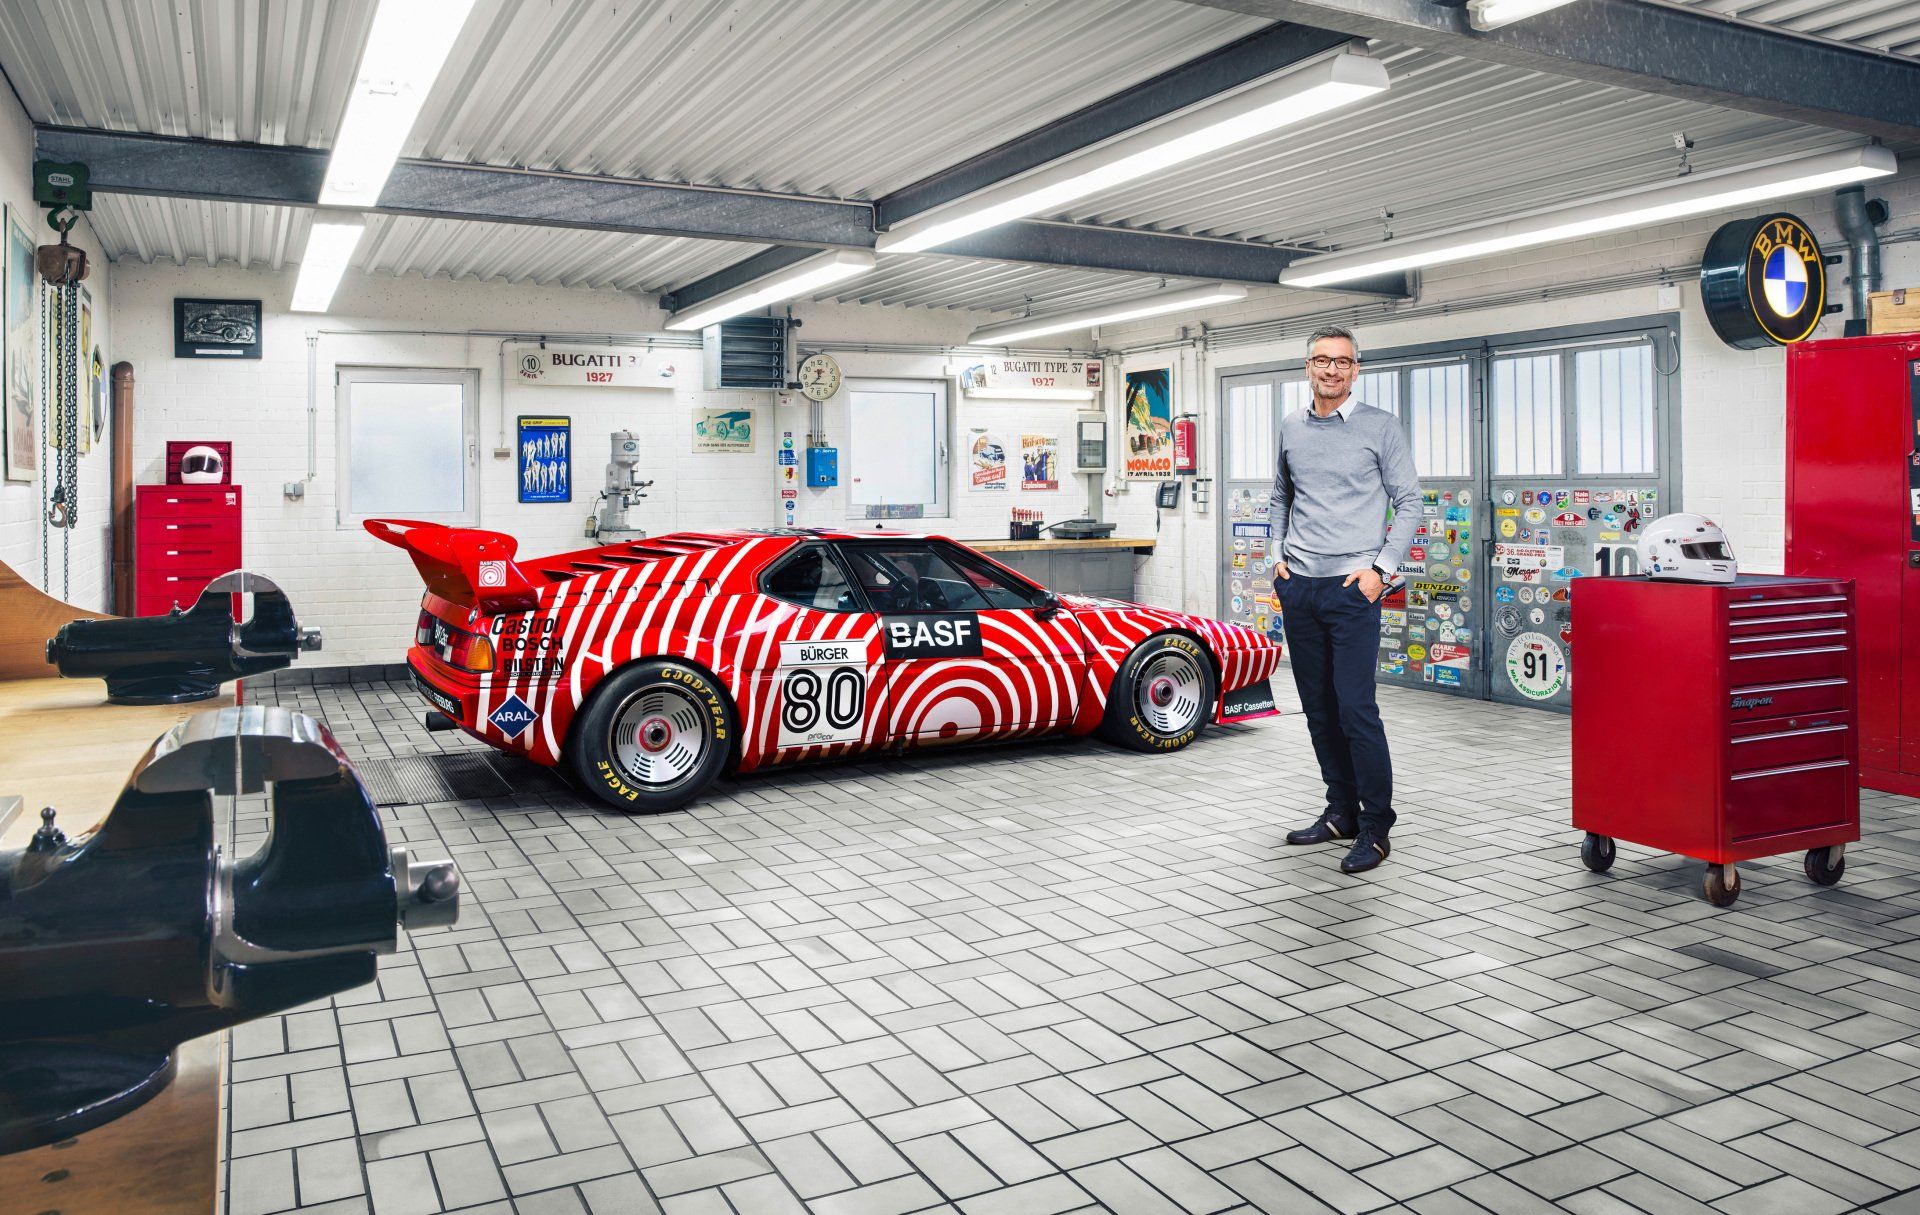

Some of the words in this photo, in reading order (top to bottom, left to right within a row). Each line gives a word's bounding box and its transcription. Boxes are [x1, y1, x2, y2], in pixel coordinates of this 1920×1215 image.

[50, 175, 71, 183] STAHL
[1755, 222, 1816, 263] BMW
[526, 358, 537, 370] 10
[552, 353, 621, 367] BUGATTI
[990, 365, 997, 375] 12
[1003, 361, 1041, 373] BUGATTI
[1044, 362, 1068, 373] TYPE
[1071, 362, 1083, 374] 37
[586, 372, 614, 383] 1927
[1031, 377, 1055, 386] 1927
[1127, 457, 1171, 471] MONACO
[1397, 565, 1425, 574] Klassik
[1414, 582, 1460, 592] DUNLOP
[492, 615, 560, 636] Castrol
[889, 620, 971, 648] BASF
[503, 636, 563, 652] BOSCH
[1164, 638, 1200, 657] EAGLE
[800, 646, 849, 661] BÜRGER
[504, 657, 564, 672] BILSTEIN
[1523, 651, 1547, 681] 91
[661, 668, 726, 740] GOODYEAR
[782, 666, 866, 734] 80
[1731, 697, 1773, 709] Snap-on
[1224, 703, 1243, 715] BASF
[1243, 700, 1275, 712] Cassetten
[495, 711, 532, 722] ARAL
[807, 732, 834, 741] procar
[1130, 715, 1195, 749] GOODYEAR
[597, 760, 639, 801] EAGLE
